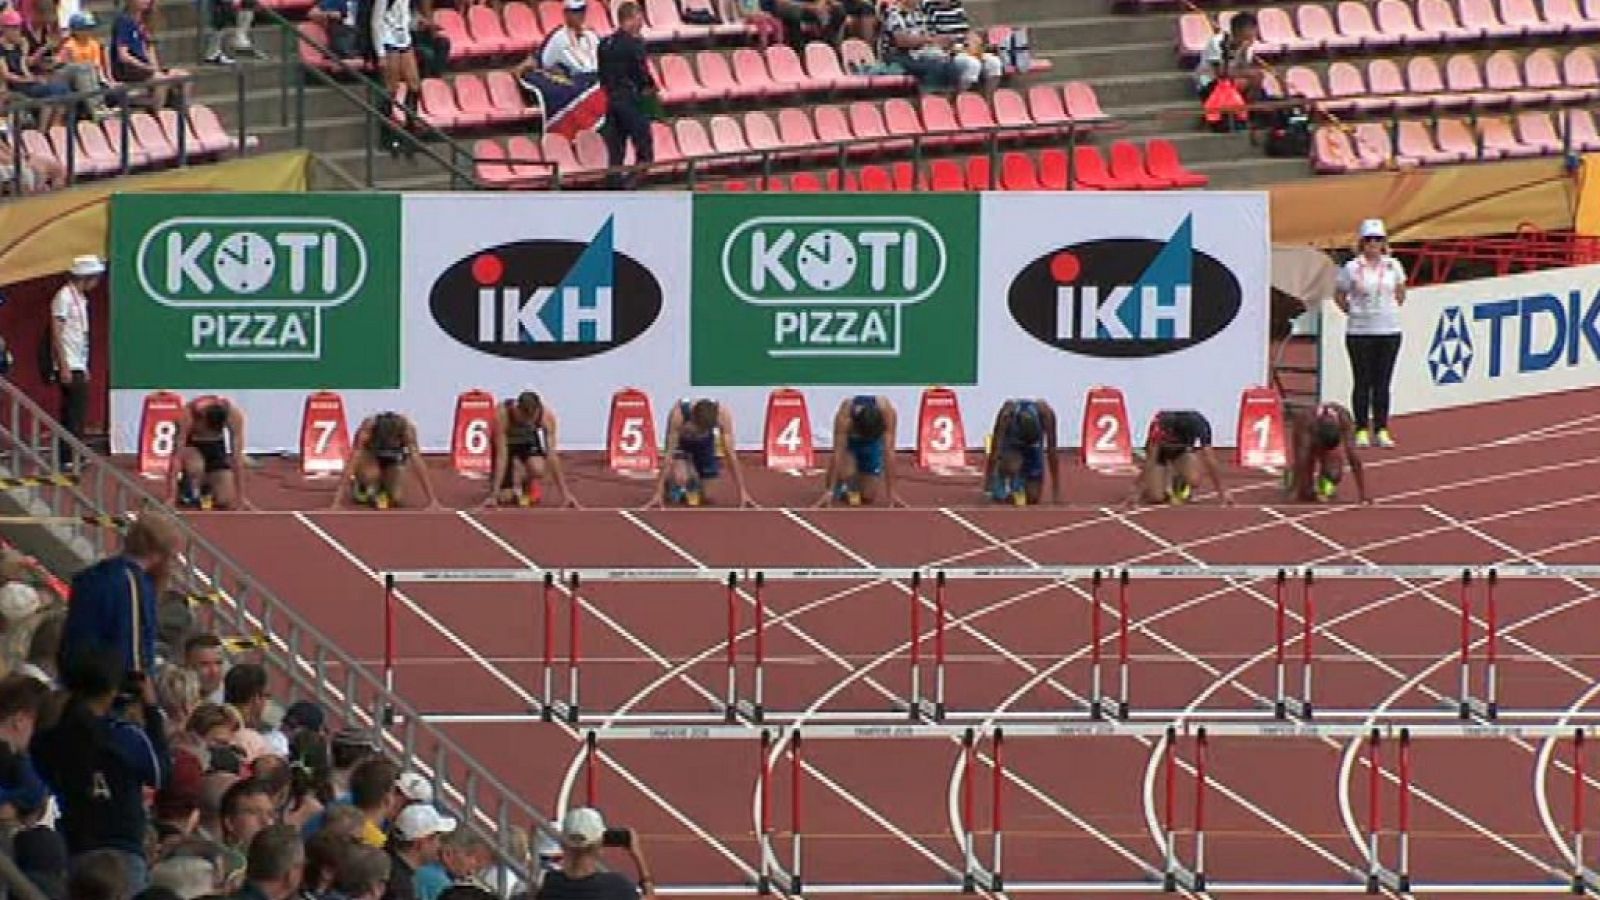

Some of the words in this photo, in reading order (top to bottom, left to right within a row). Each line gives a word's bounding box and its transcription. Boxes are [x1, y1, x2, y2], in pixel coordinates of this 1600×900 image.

[166, 230, 338, 295] KOTI
[751, 229, 918, 293] KOTI
[192, 313, 308, 348] PIZZA
[775, 312, 888, 344] PIZZA
[1473, 289, 1600, 377] TDK
[152, 420, 177, 457] 8
[312, 420, 337, 455] 7
[465, 419, 489, 455] 6
[619, 417, 645, 454] 5
[776, 416, 802, 452] 4
[930, 416, 955, 452] 3
[1095, 415, 1120, 452] 2
[1252, 415, 1273, 452] 1
